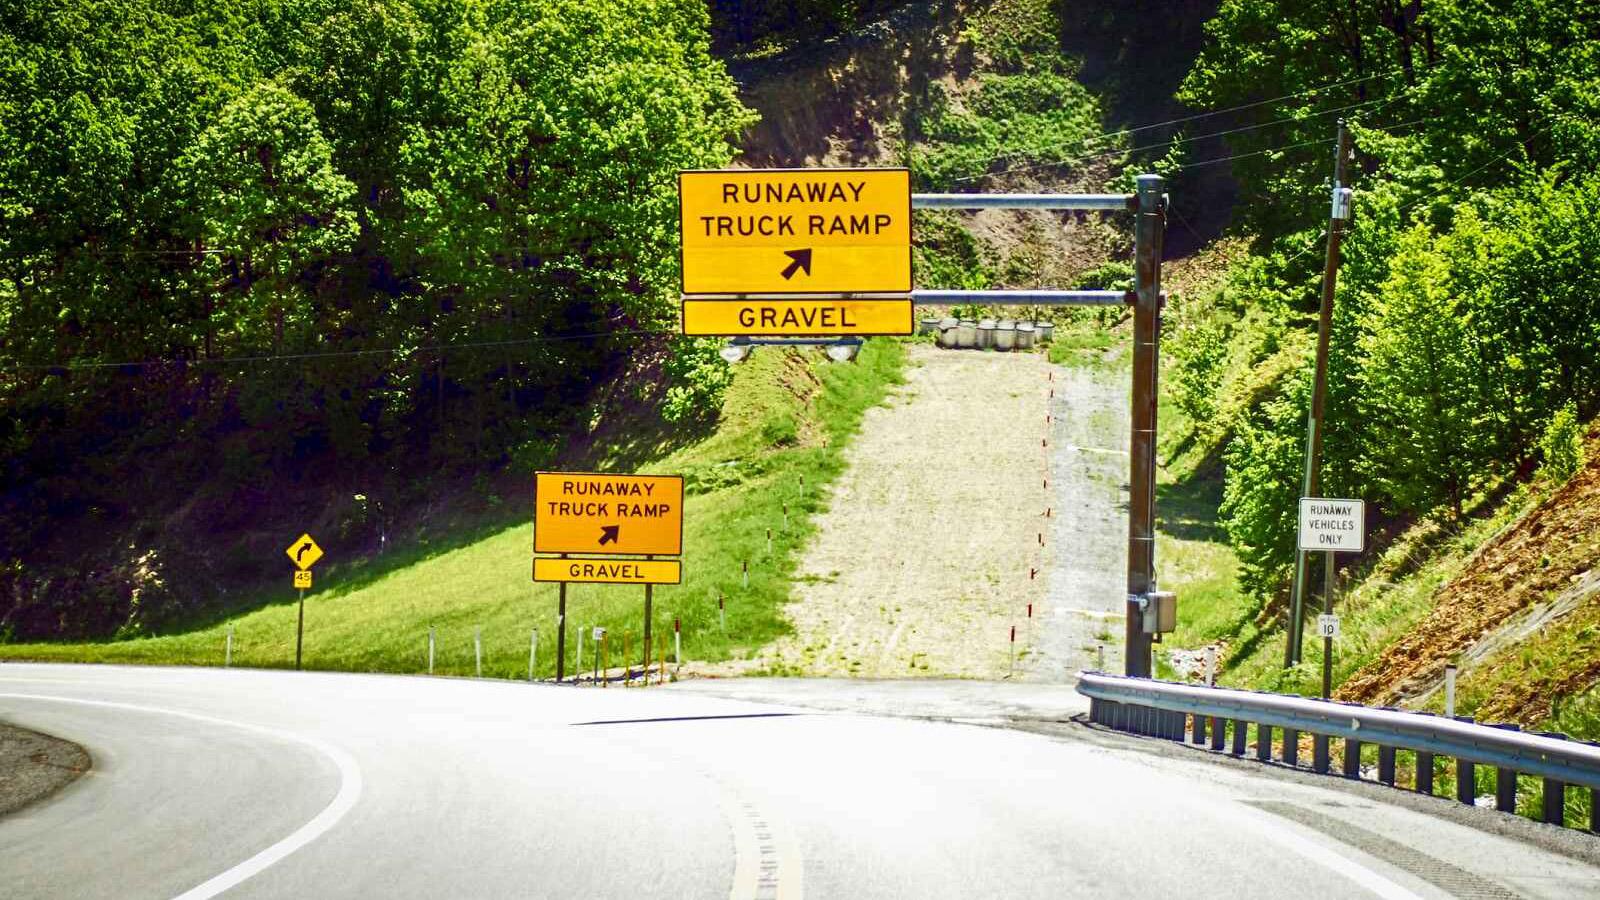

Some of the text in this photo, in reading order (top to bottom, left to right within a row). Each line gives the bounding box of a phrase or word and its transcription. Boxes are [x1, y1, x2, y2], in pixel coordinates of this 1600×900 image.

[723, 182, 866, 203] RUNAWAY
[701, 215, 891, 236] TRUCK RAMP
[739, 307, 856, 328] GRAVEL
[563, 481, 655, 496] RUNAWAY
[548, 502, 670, 517] TRUCK RAMP
[1310, 505, 1352, 516] RUNAWAY
[1309, 519, 1354, 530] VEHICLES
[1319, 533, 1342, 544] ONLY
[296, 572, 310, 581] 45
[570, 564, 645, 578] GRAVEL
[1323, 624, 1335, 635] 10
